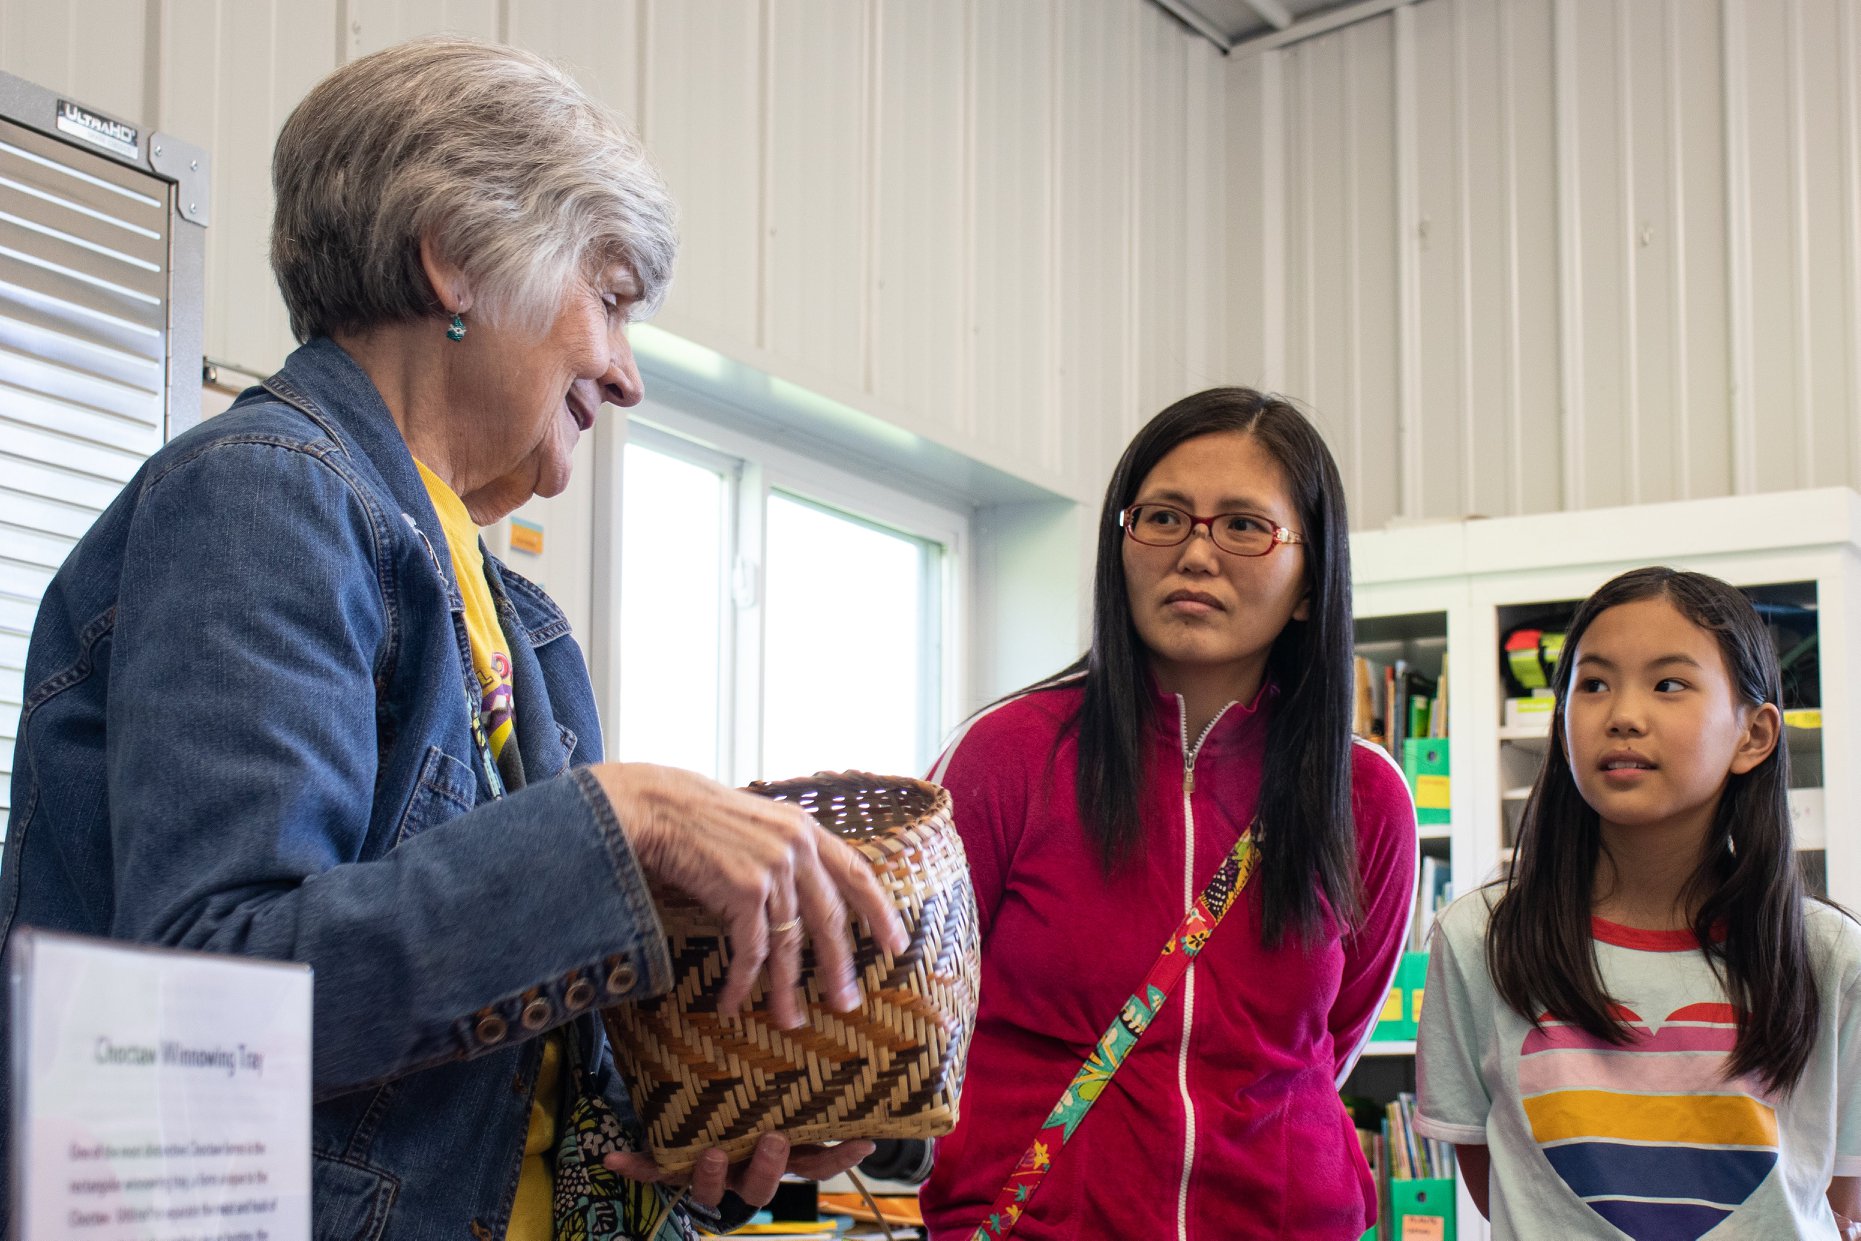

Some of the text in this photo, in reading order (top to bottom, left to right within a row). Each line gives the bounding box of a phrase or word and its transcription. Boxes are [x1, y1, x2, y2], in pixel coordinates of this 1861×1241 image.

[96, 1037, 264, 1078] Choctaw Winnowing Tray
